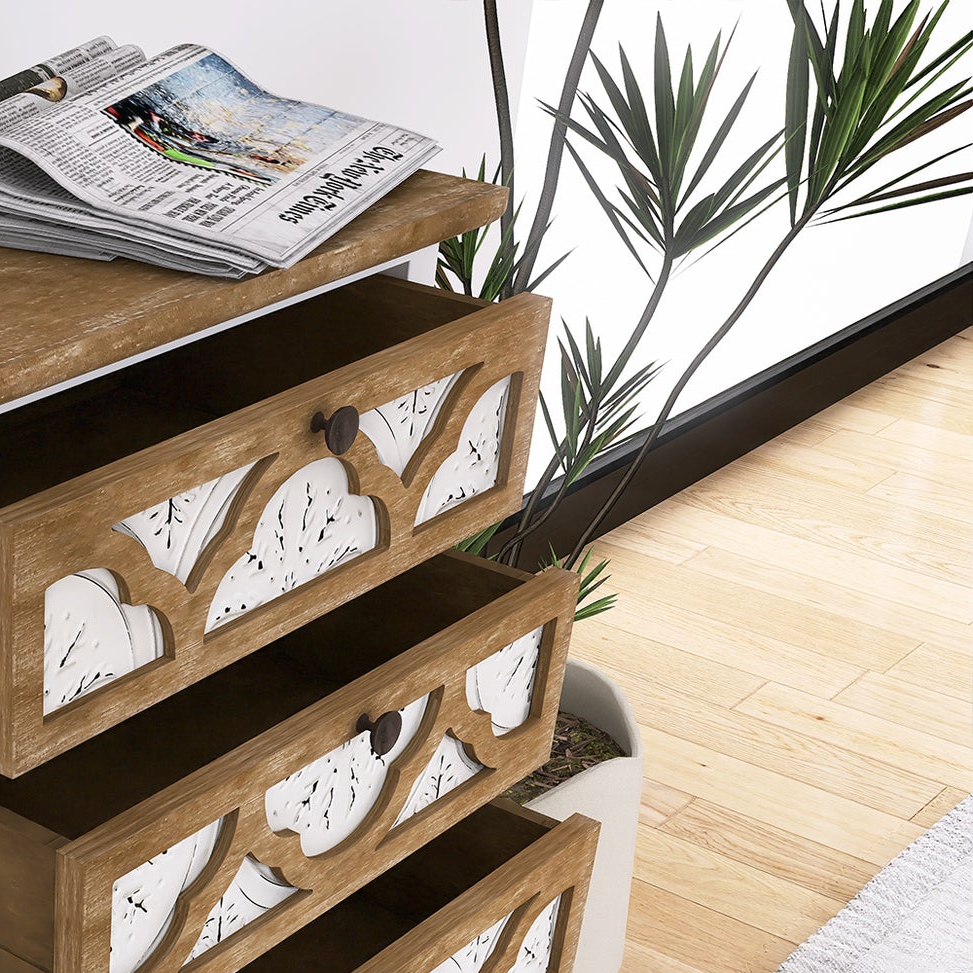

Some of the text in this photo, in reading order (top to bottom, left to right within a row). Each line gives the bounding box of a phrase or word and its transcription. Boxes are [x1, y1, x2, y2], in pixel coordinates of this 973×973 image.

[362, 146, 404, 162] The
[341, 158, 385, 180] New
[313, 172, 363, 200] York
[279, 195, 337, 224] Times
